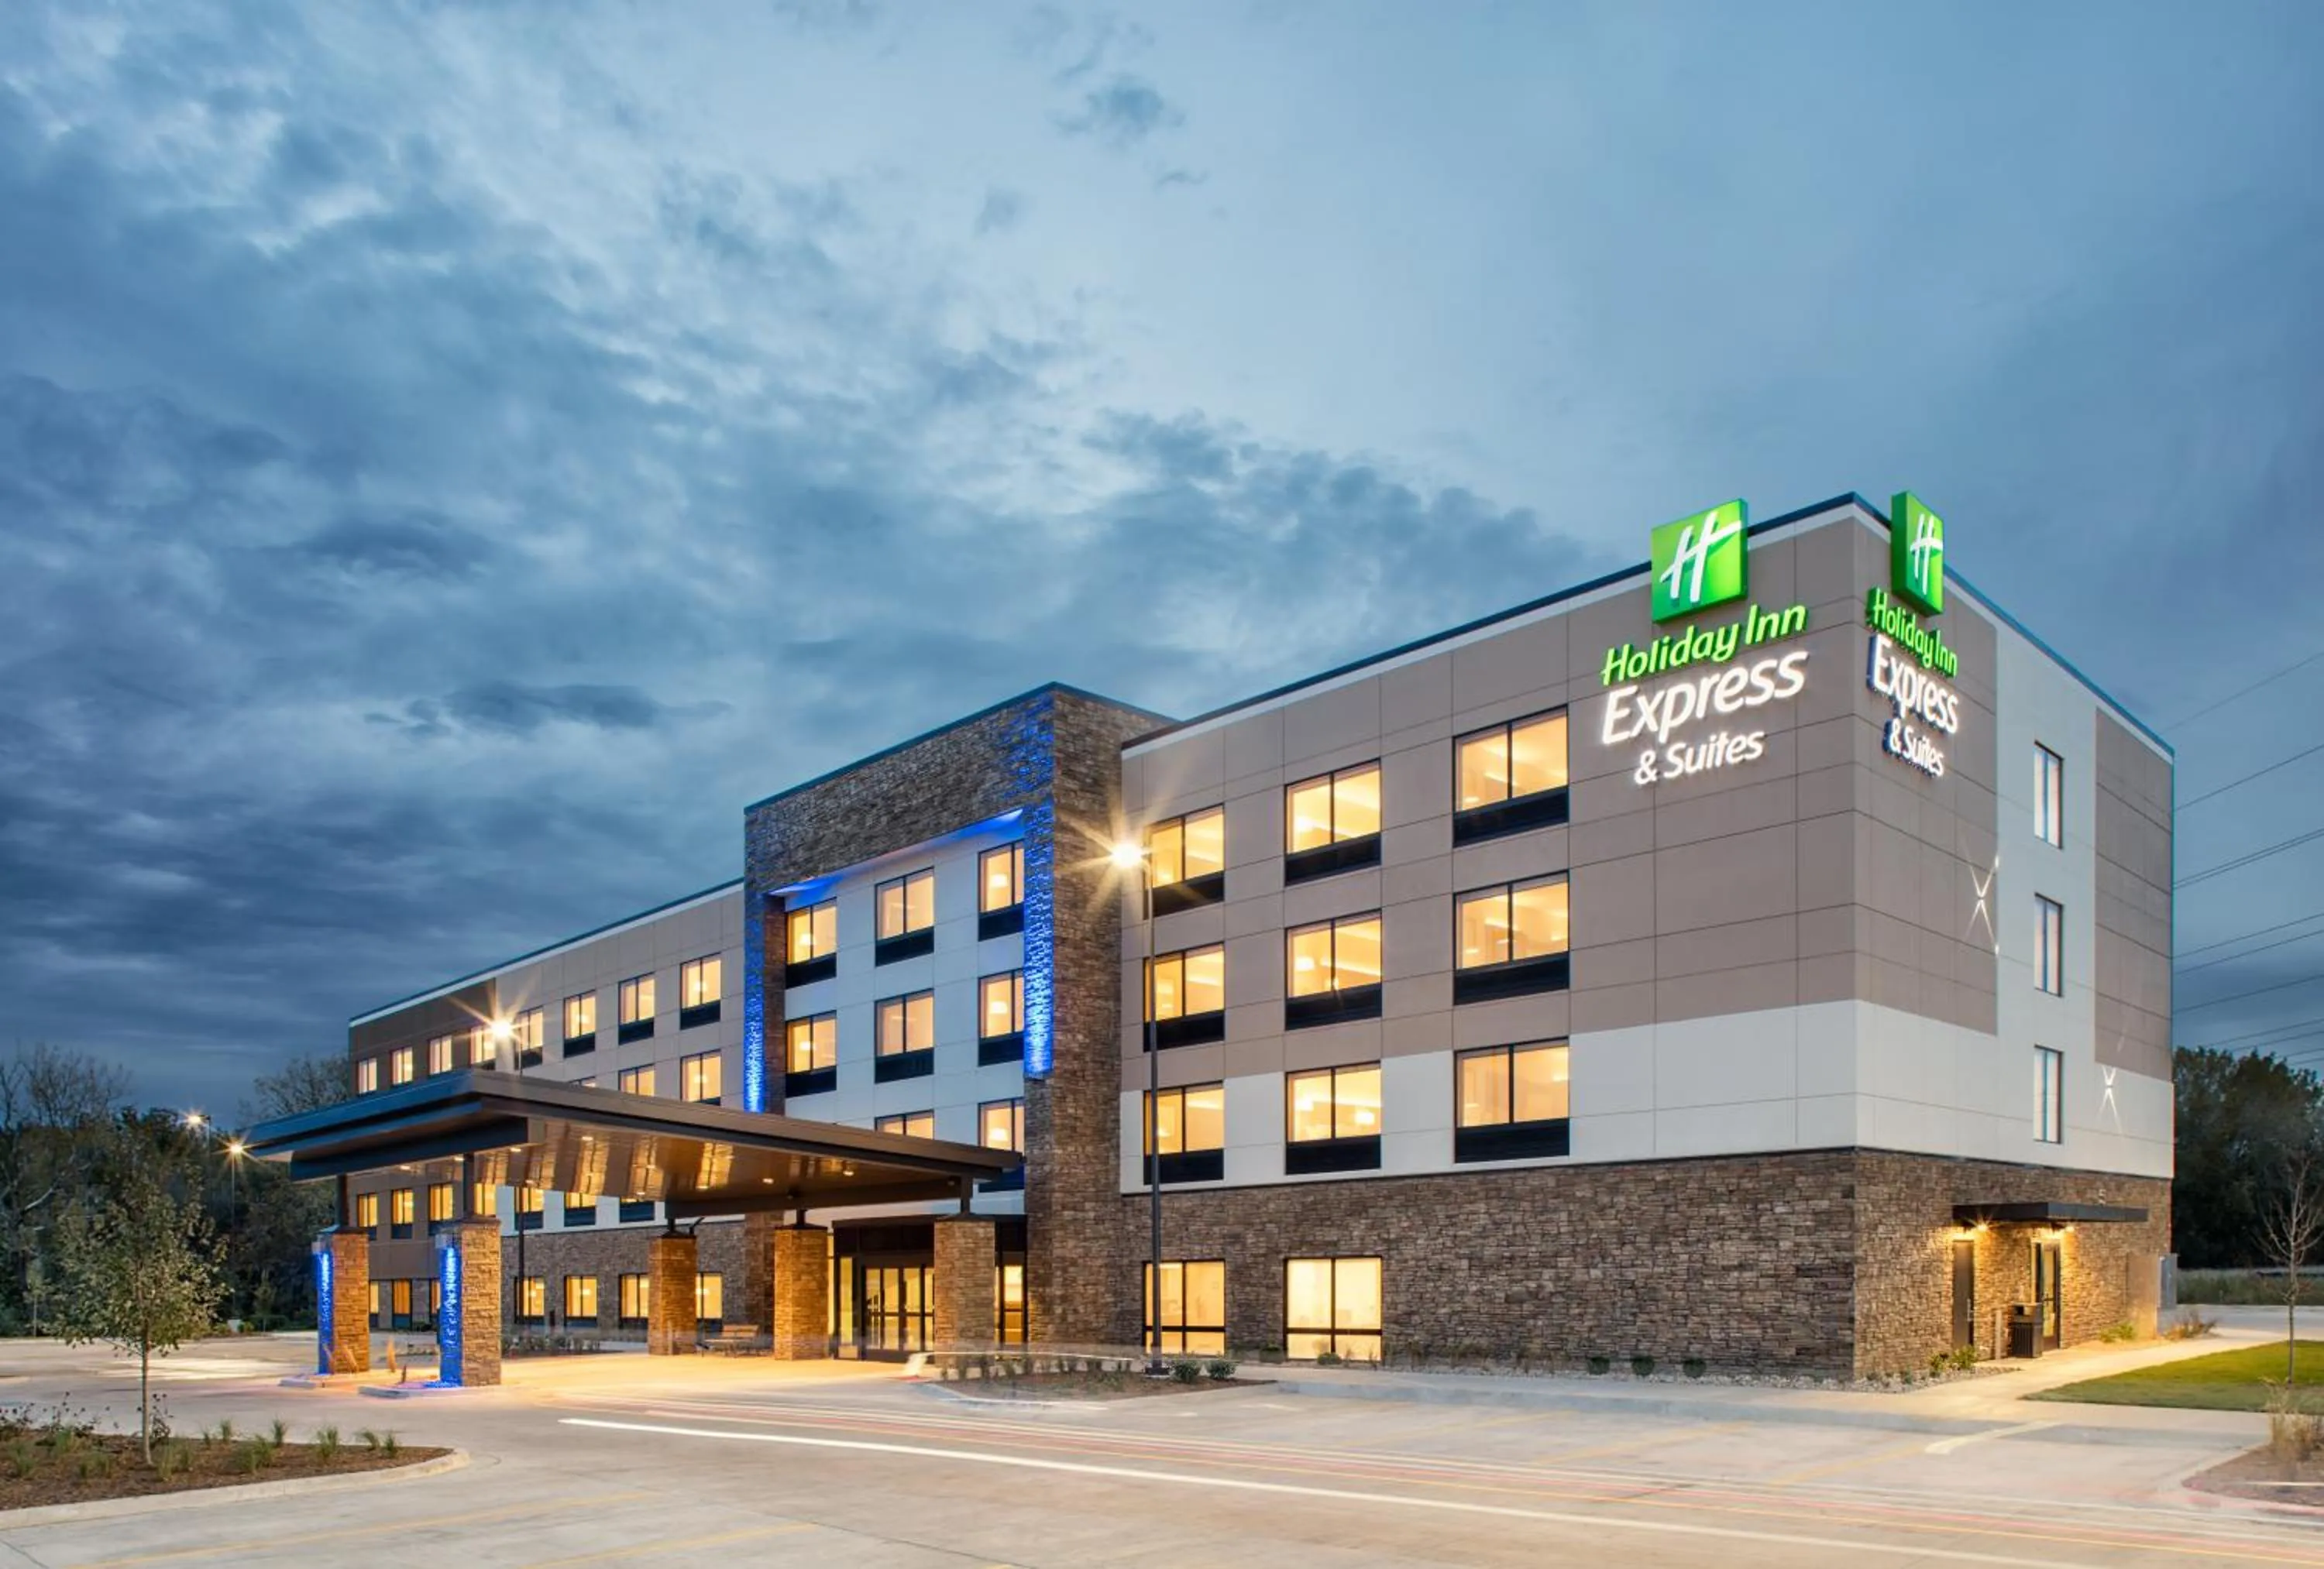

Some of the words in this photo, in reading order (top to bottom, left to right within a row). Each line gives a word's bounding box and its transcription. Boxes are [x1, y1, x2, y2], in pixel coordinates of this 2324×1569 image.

[1659, 510, 1742, 603] H
[1910, 513, 1943, 595] H
[1600, 623, 1741, 686] Holiday
[1745, 604, 1807, 645] Inn
[1872, 587, 1934, 669] Holiday
[1935, 629, 1958, 678] Inn
[1601, 651, 1810, 745] Express
[1872, 633, 1959, 734] Express
[1633, 749, 1658, 785] &
[1663, 730, 1765, 778] Suites
[1888, 717, 1902, 754] &
[1903, 724, 1944, 778] Suites
